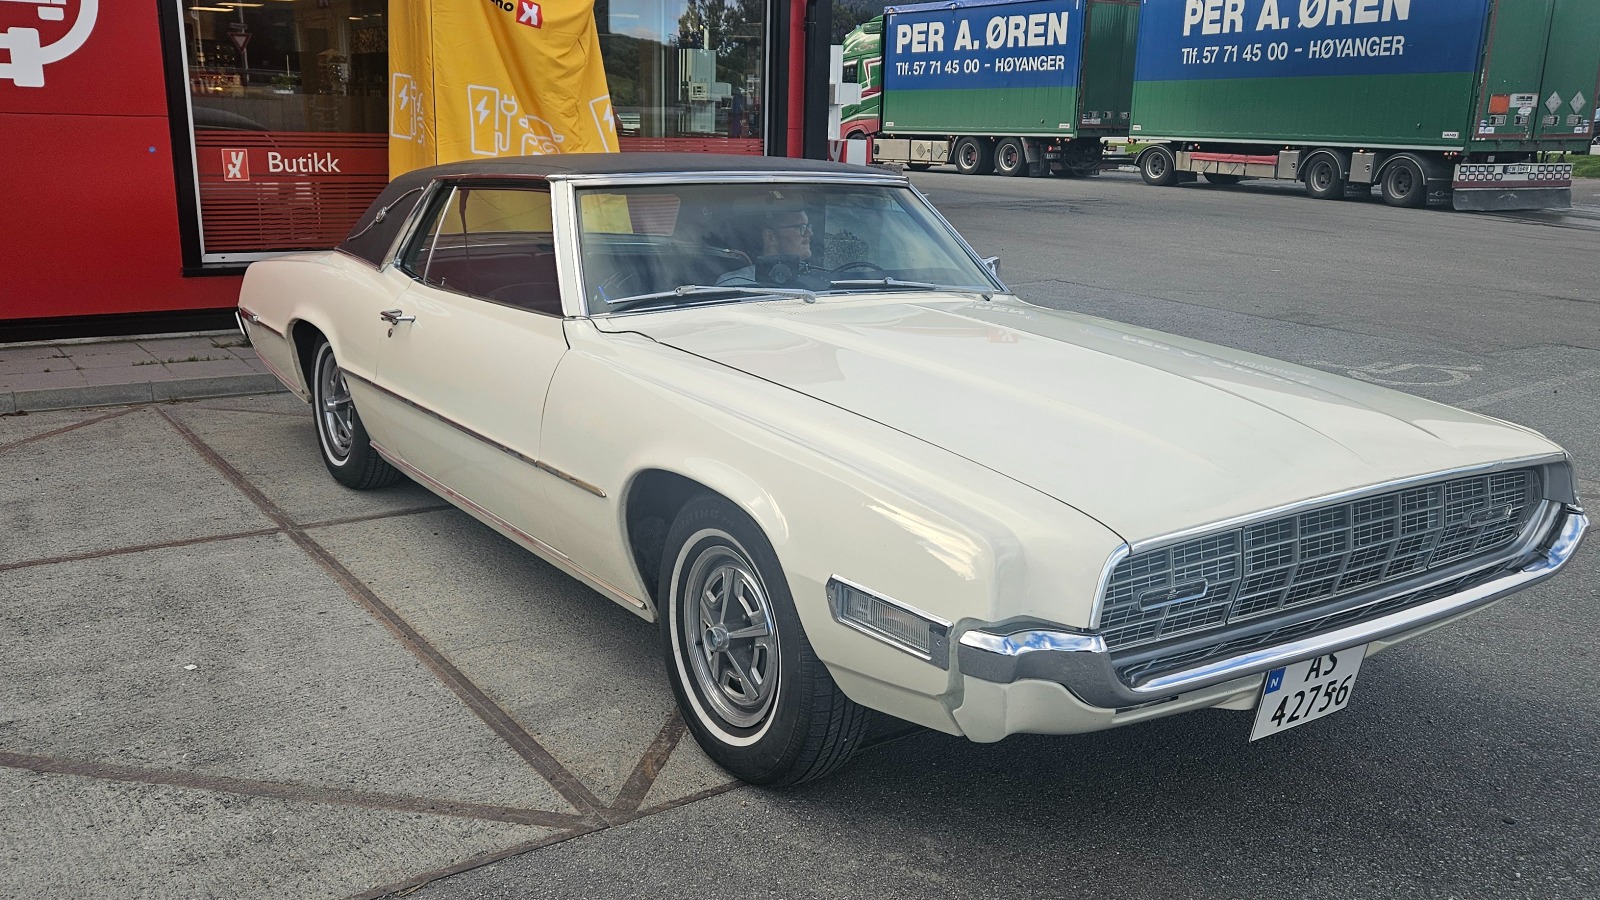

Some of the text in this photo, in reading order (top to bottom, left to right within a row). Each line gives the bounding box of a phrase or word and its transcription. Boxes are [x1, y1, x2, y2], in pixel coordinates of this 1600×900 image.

[896, 11, 1069, 54] PER A. ØREN
[1182, 0, 1410, 37] PER A. ØREN
[1181, 48, 1200, 64] Tlf.
[1202, 46, 1218, 63] 57
[1223, 45, 1238, 63] 71
[1242, 43, 1262, 62] 45
[1267, 42, 1288, 61] 00
[1308, 35, 1405, 59] HØYANGER
[912, 61, 926, 75] 57
[929, 60, 941, 74] 71
[944, 60, 959, 74] 45
[963, 58, 980, 73] 00
[995, 55, 1065, 73] HØYANGER
[267, 151, 341, 173] Butikk
[1304, 653, 1338, 682] AS
[1270, 678, 1278, 688] N
[1271, 674, 1352, 727] 42756
